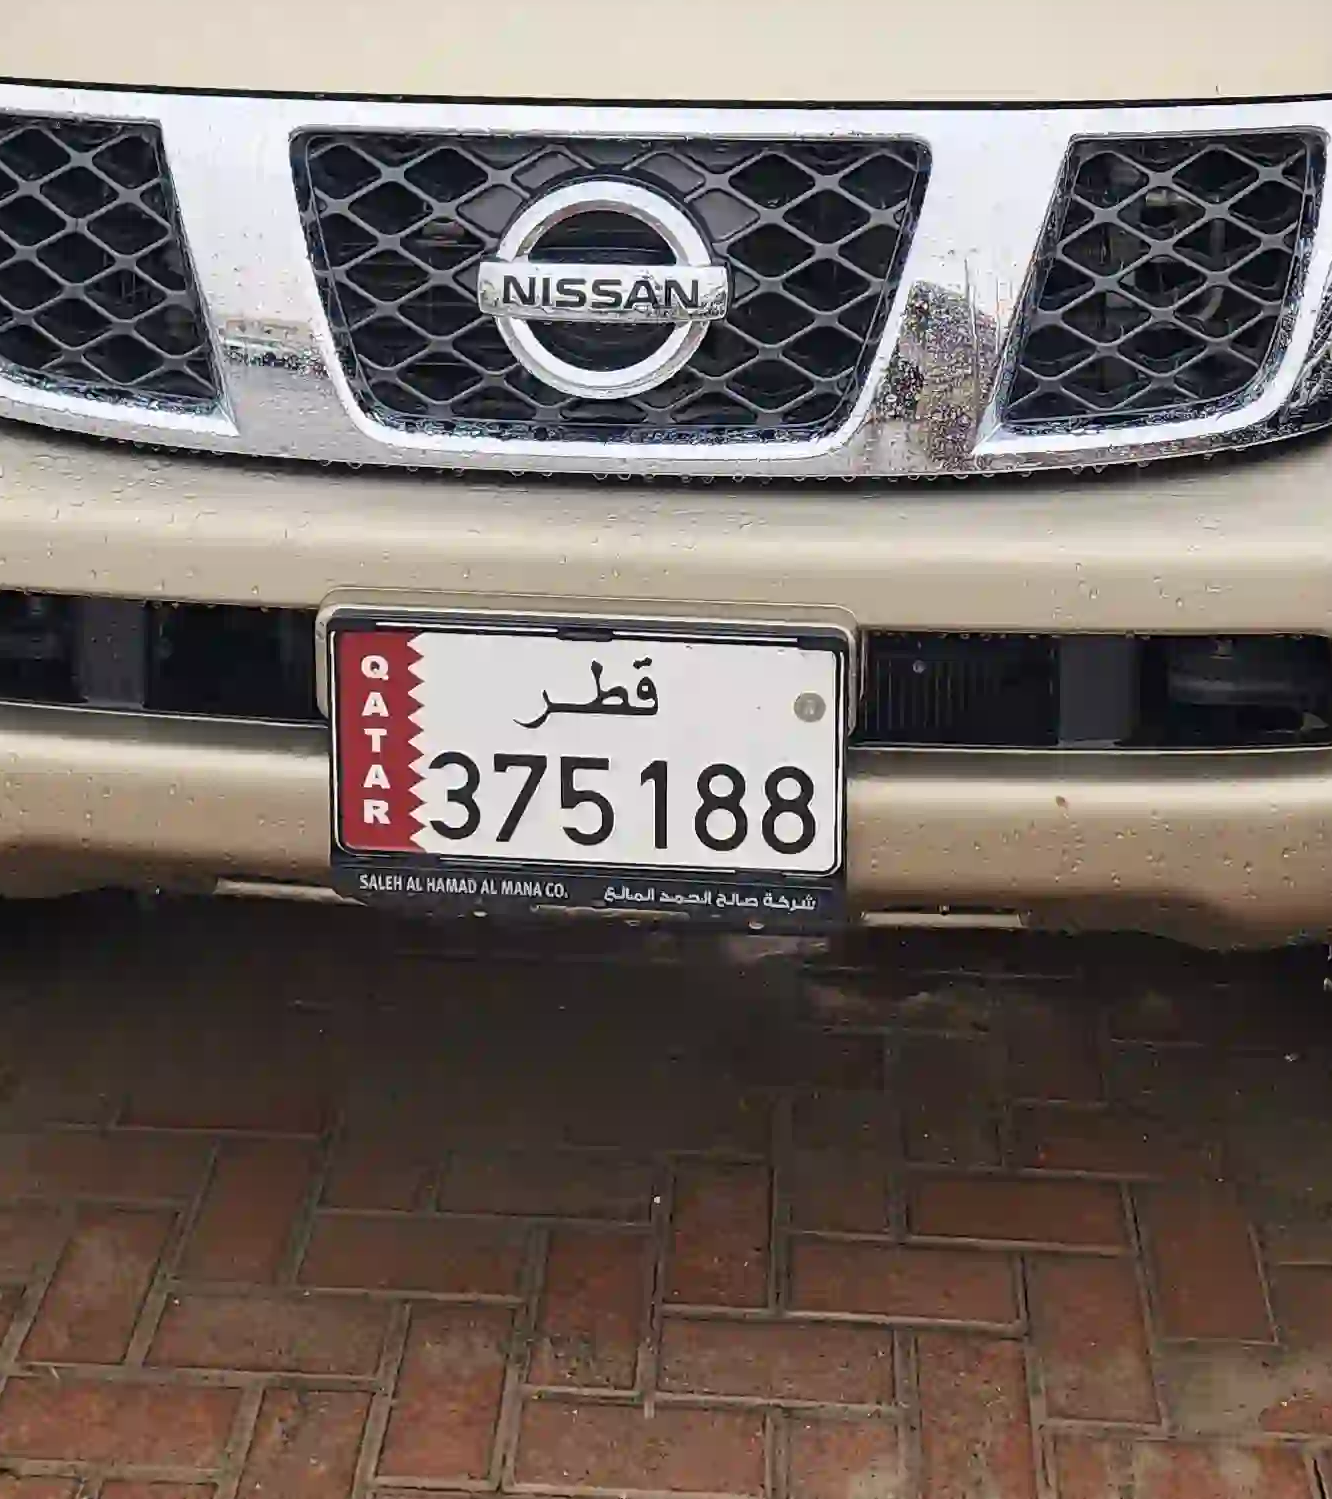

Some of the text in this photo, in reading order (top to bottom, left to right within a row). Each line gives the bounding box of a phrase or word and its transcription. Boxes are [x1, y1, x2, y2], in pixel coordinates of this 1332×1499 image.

[502, 275, 700, 310] NISSAN
[513, 656, 659, 729] قطر
[360, 655, 391, 825] QATAR
[428, 751, 817, 855] 375188
[359, 873, 569, 899] SALEH AL HAMAD AL MANA CO.
[659, 889, 713, 906] الحمد
[715, 891, 760, 908] صالح
